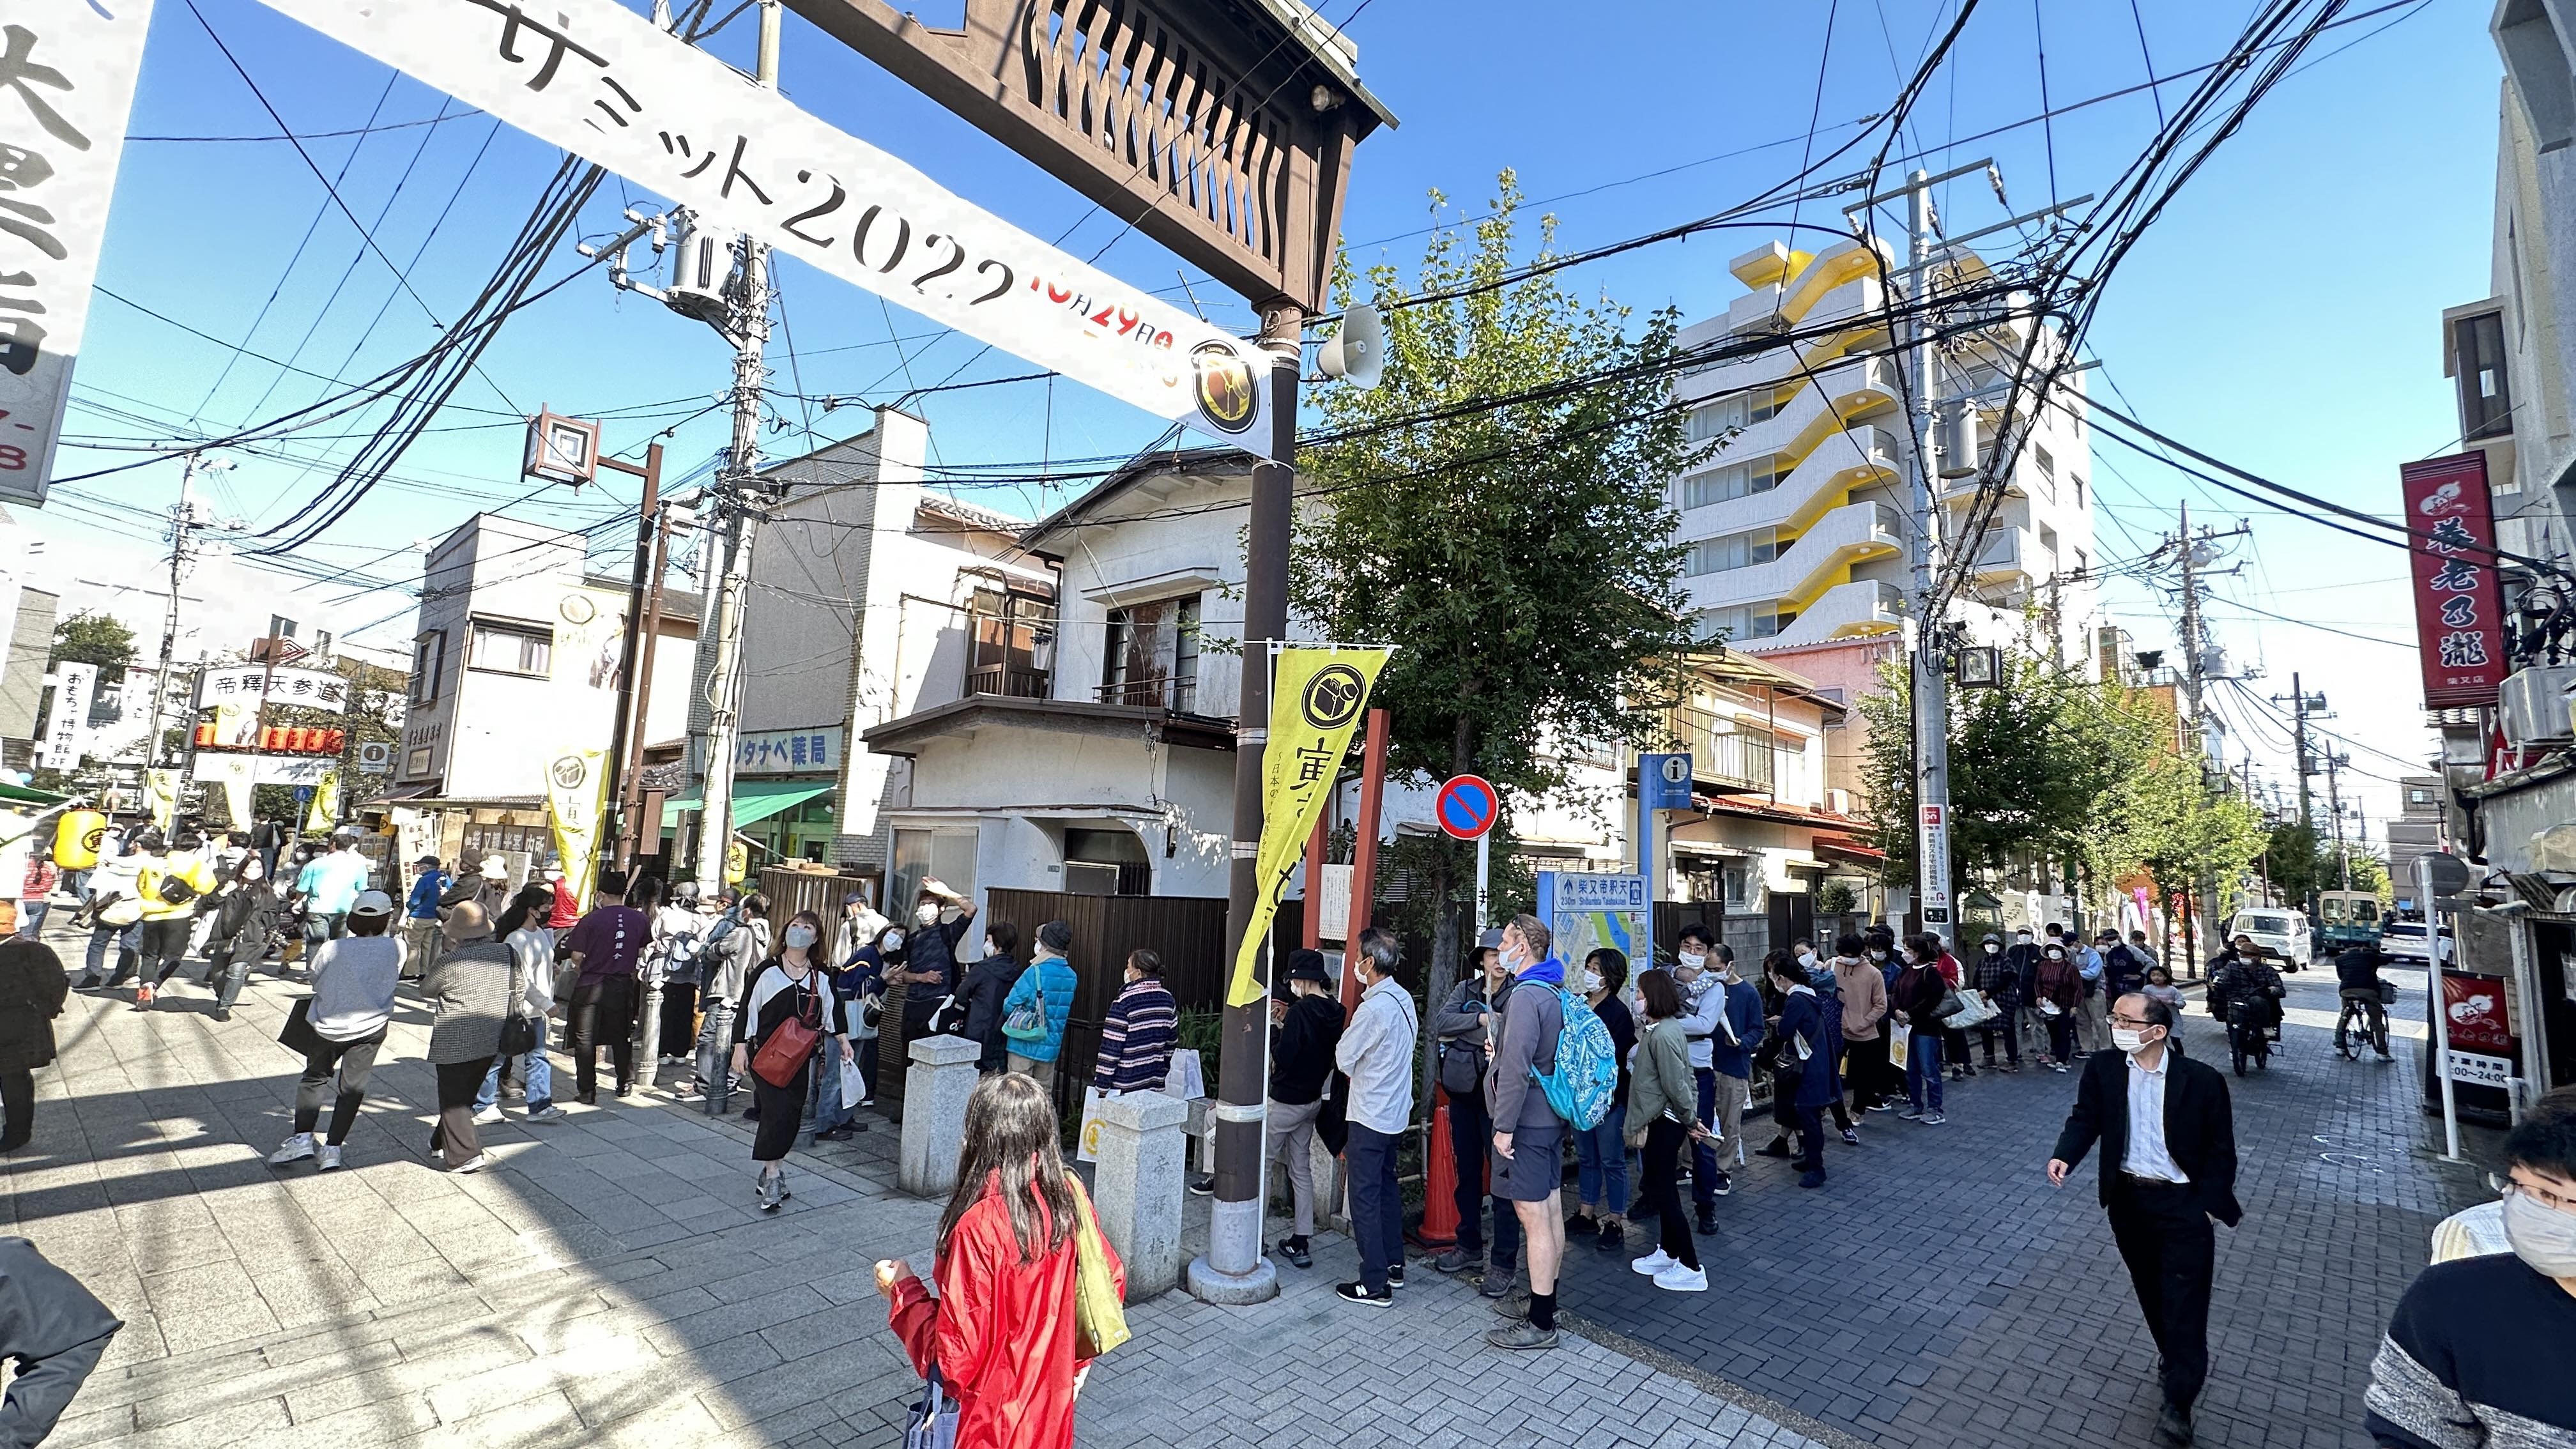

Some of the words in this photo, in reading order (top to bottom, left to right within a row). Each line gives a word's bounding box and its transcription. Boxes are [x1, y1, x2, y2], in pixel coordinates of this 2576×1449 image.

[2426, 516, 2489, 667] 養老乃瀧
[1578, 878, 1628, 895] 柴又帝釈天
